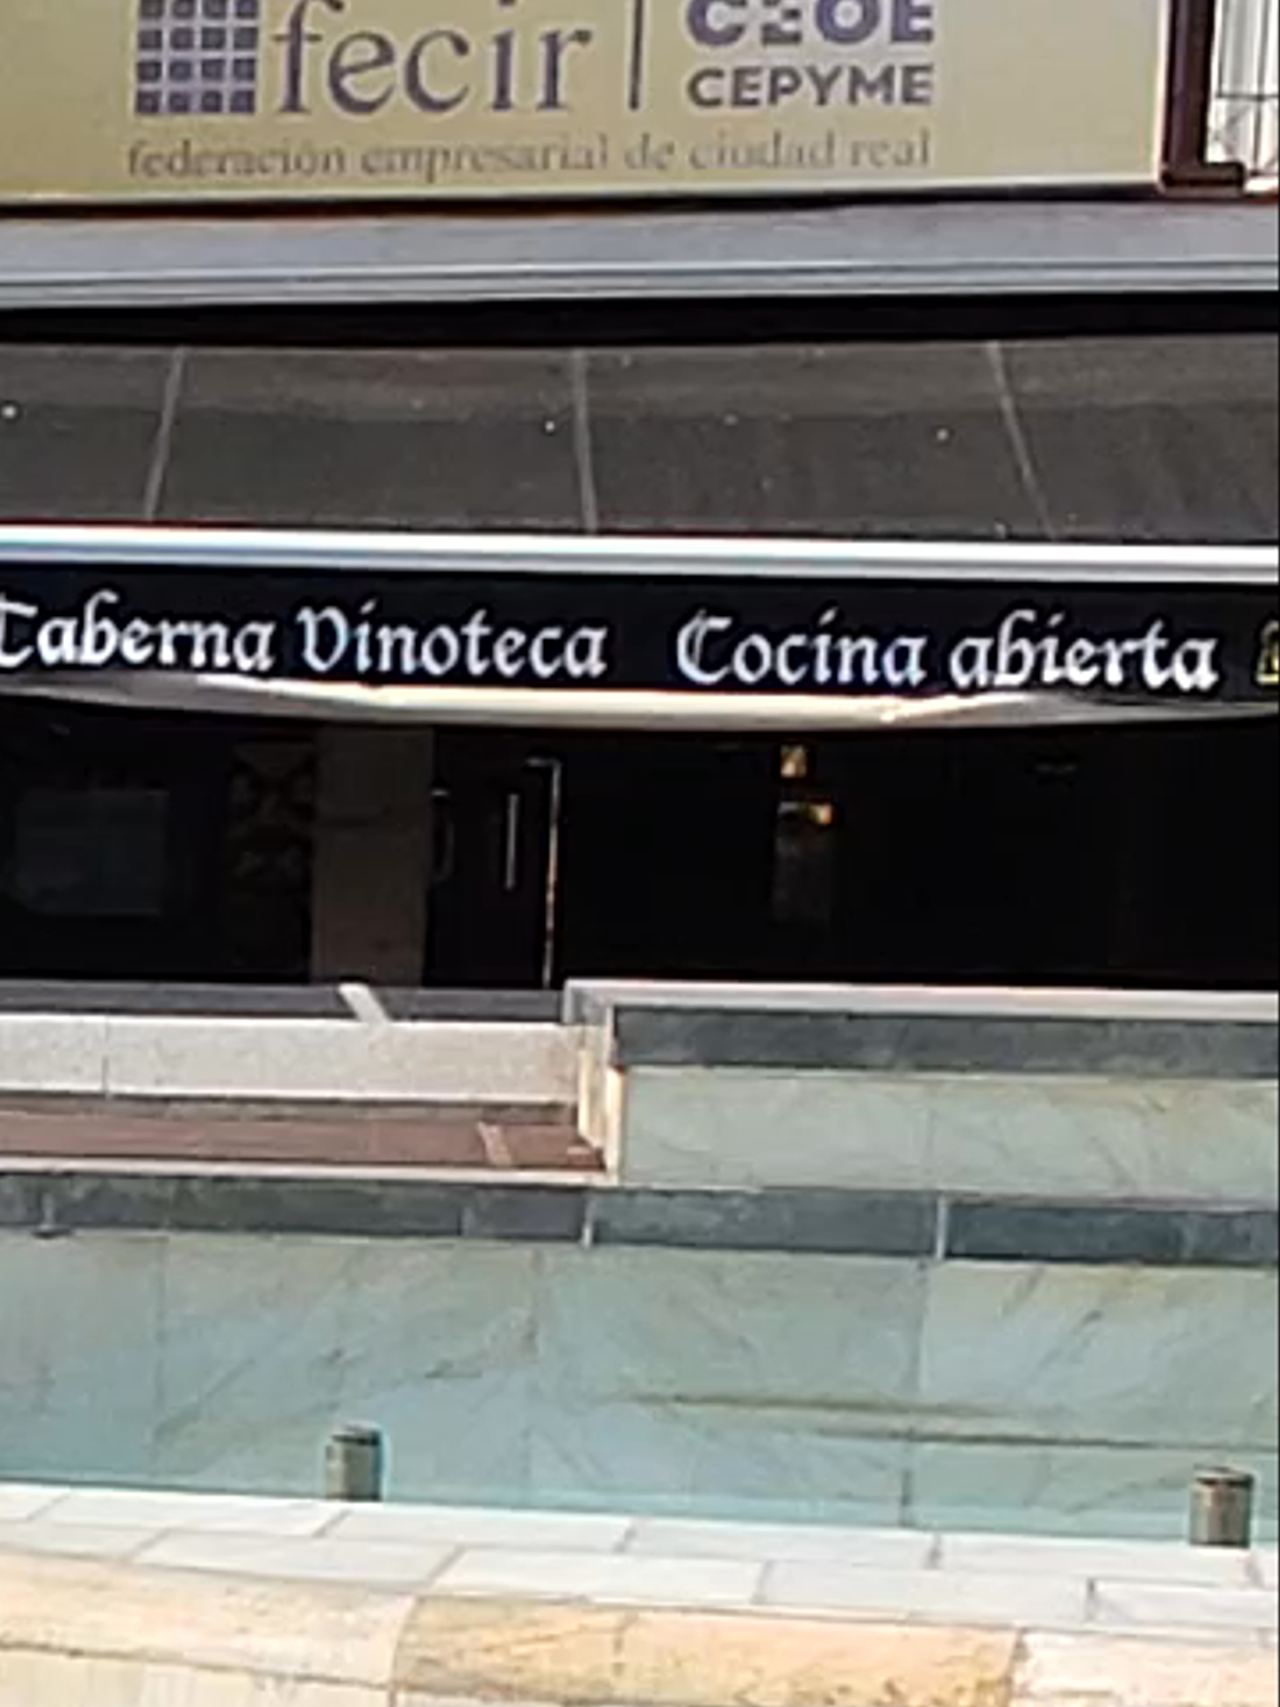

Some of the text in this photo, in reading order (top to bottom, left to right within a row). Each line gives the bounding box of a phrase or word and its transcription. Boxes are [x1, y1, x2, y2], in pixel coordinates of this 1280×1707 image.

[687, 65, 934, 109] CEPYME
[127, 129, 931, 184] federación empresarial de ciudad real
[295, 599, 608, 677] Vinoteca
[676, 607, 928, 687] Cocina
[949, 610, 1220, 690] abierta
